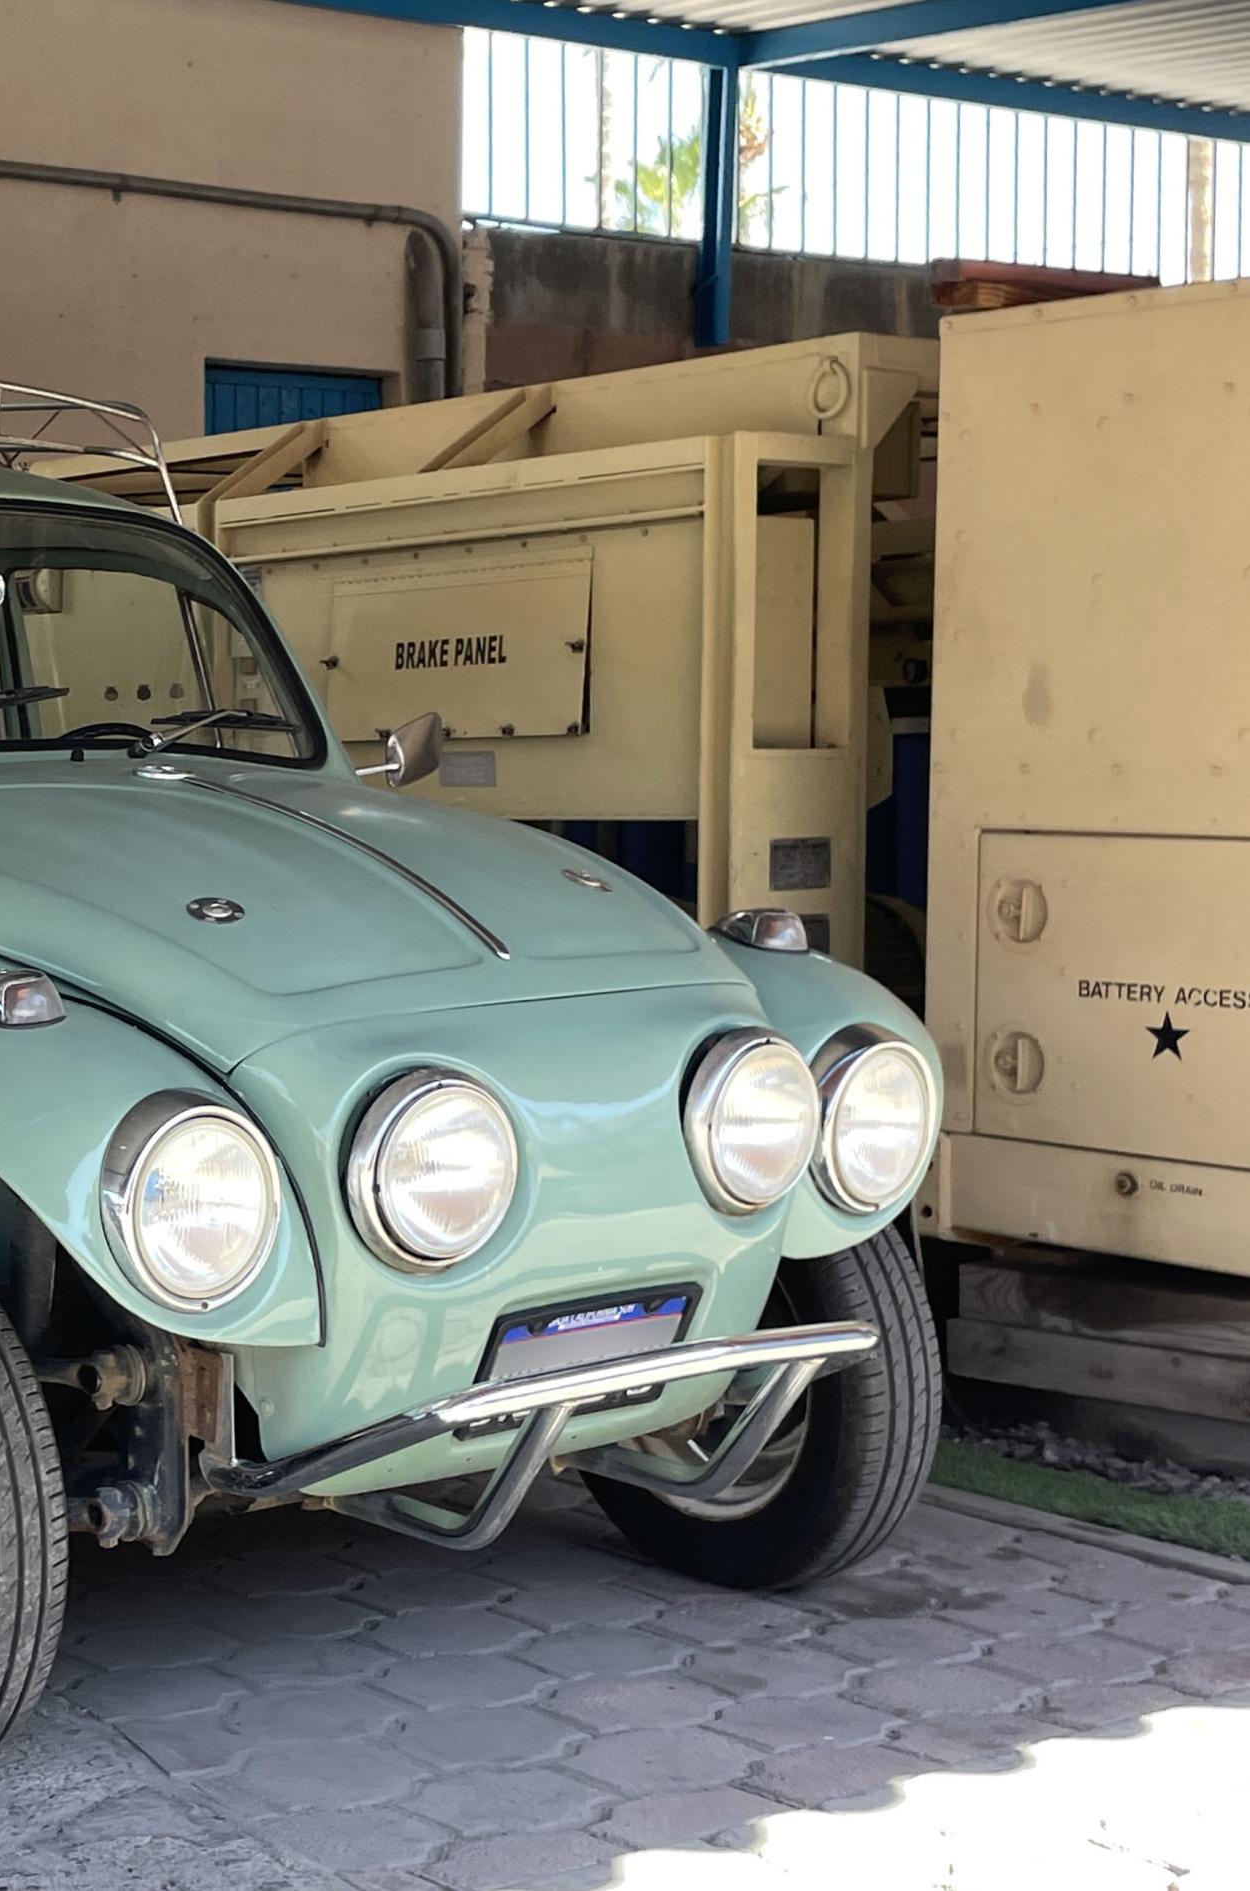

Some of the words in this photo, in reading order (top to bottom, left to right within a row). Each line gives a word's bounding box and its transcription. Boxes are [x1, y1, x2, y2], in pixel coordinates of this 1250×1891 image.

[395, 640, 449, 670] BRAKE
[454, 635, 507, 666] PANEL
[1078, 979, 1165, 1003] BATTERY
[1150, 1180, 1165, 1191] OIL
